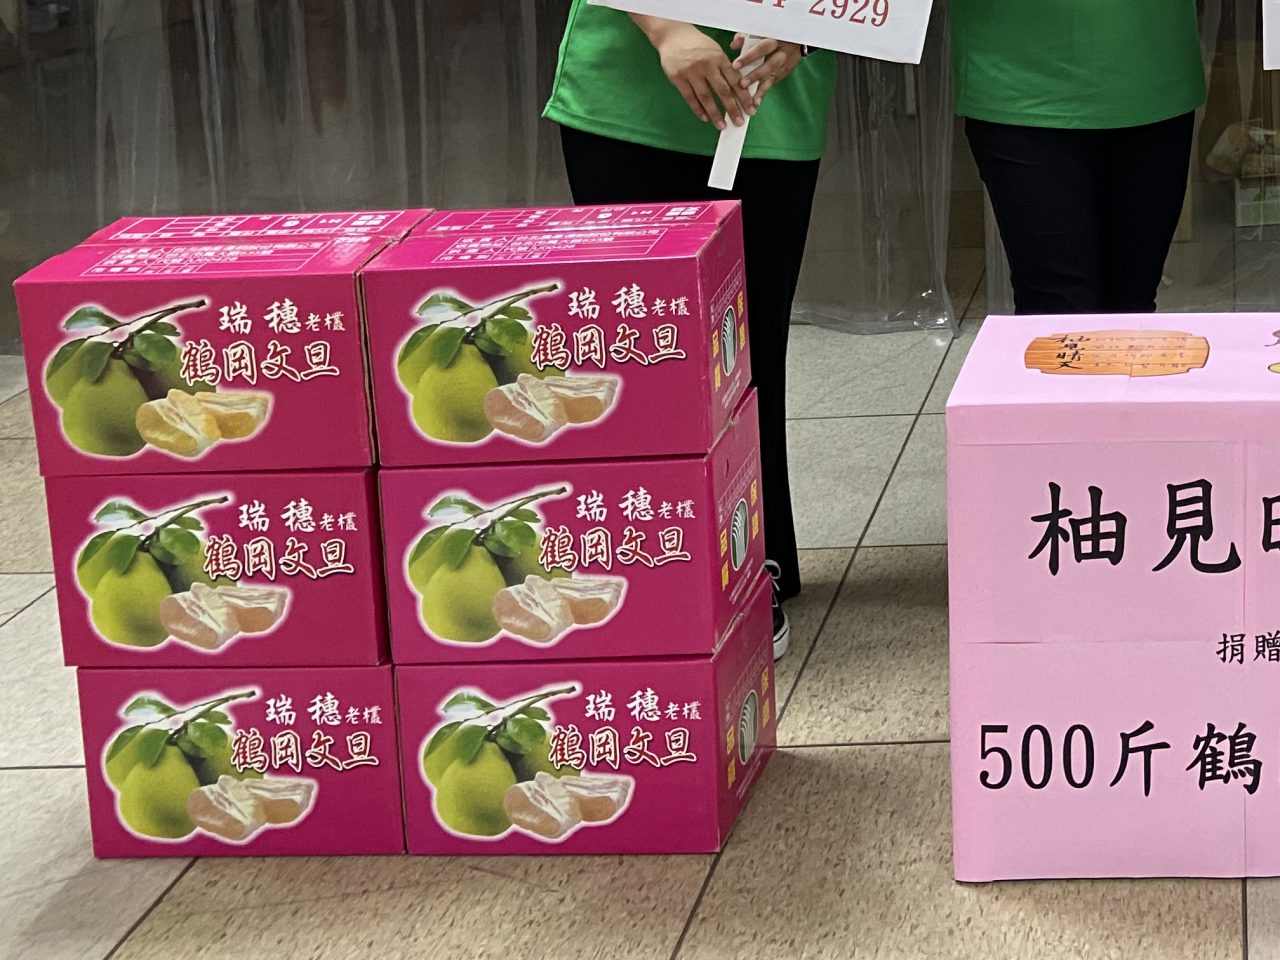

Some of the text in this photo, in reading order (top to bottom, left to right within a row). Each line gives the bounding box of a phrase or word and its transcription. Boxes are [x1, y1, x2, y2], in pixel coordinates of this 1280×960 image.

[180, 339, 340, 386] 鶴岡文旦
[531, 324, 687, 370] 鶴岡文旦
[203, 535, 354, 580] 鶴岡文旦
[538, 525, 692, 572] 鶴岡文旦
[230, 728, 379, 773] 鶴岡文旦
[548, 725, 697, 771] 鶴岡文旦
